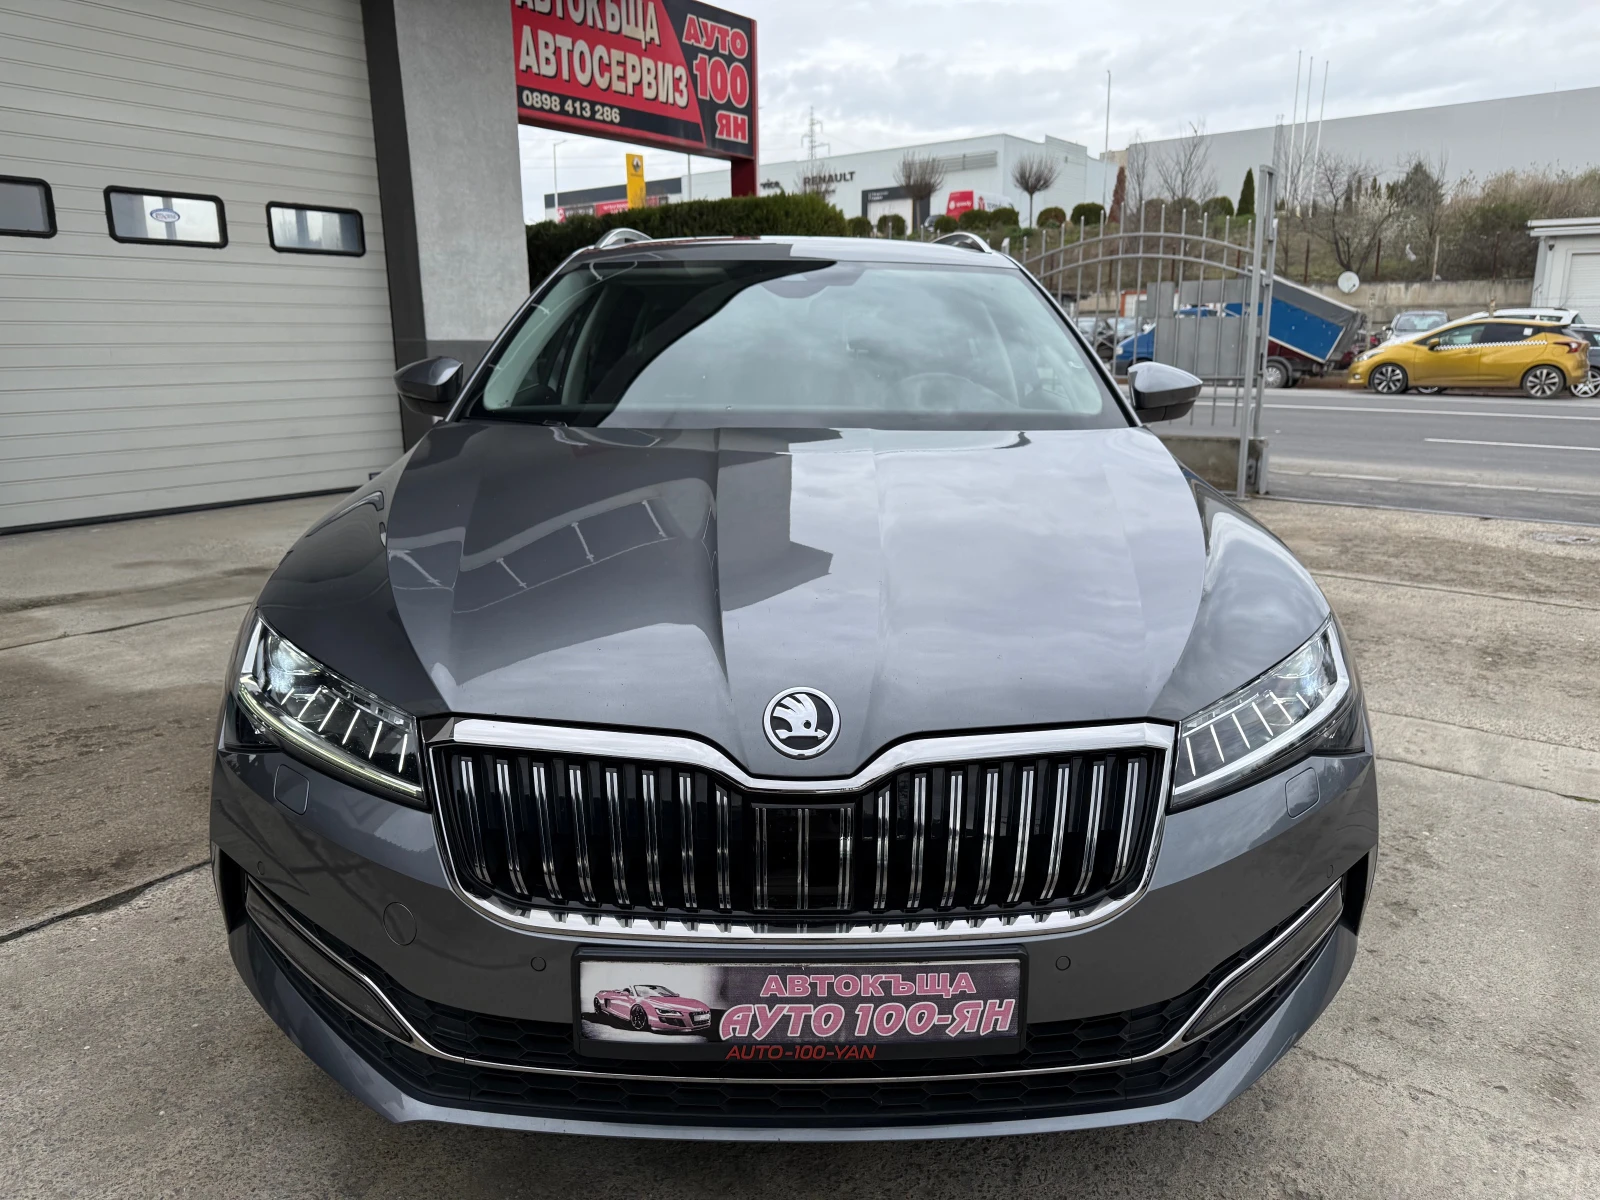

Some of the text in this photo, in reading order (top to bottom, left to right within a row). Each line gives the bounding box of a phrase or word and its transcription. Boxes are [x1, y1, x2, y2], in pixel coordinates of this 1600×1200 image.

[516, 0, 661, 49] ОКЪЩА
[682, 13, 749, 59] АУТО
[519, 24, 689, 108] АВТОСЕРВИЗ
[693, 53, 749, 108] 100
[522, 89, 621, 123] 0898 413 286
[715, 110, 749, 144] ЯН
[803, 171, 856, 186] RENAULT
[760, 971, 977, 998] АВТОКЪЩА
[720, 999, 1016, 1041] АУТО 100-ЯН
[725, 1045, 877, 1060] AUTO-100-YAN
